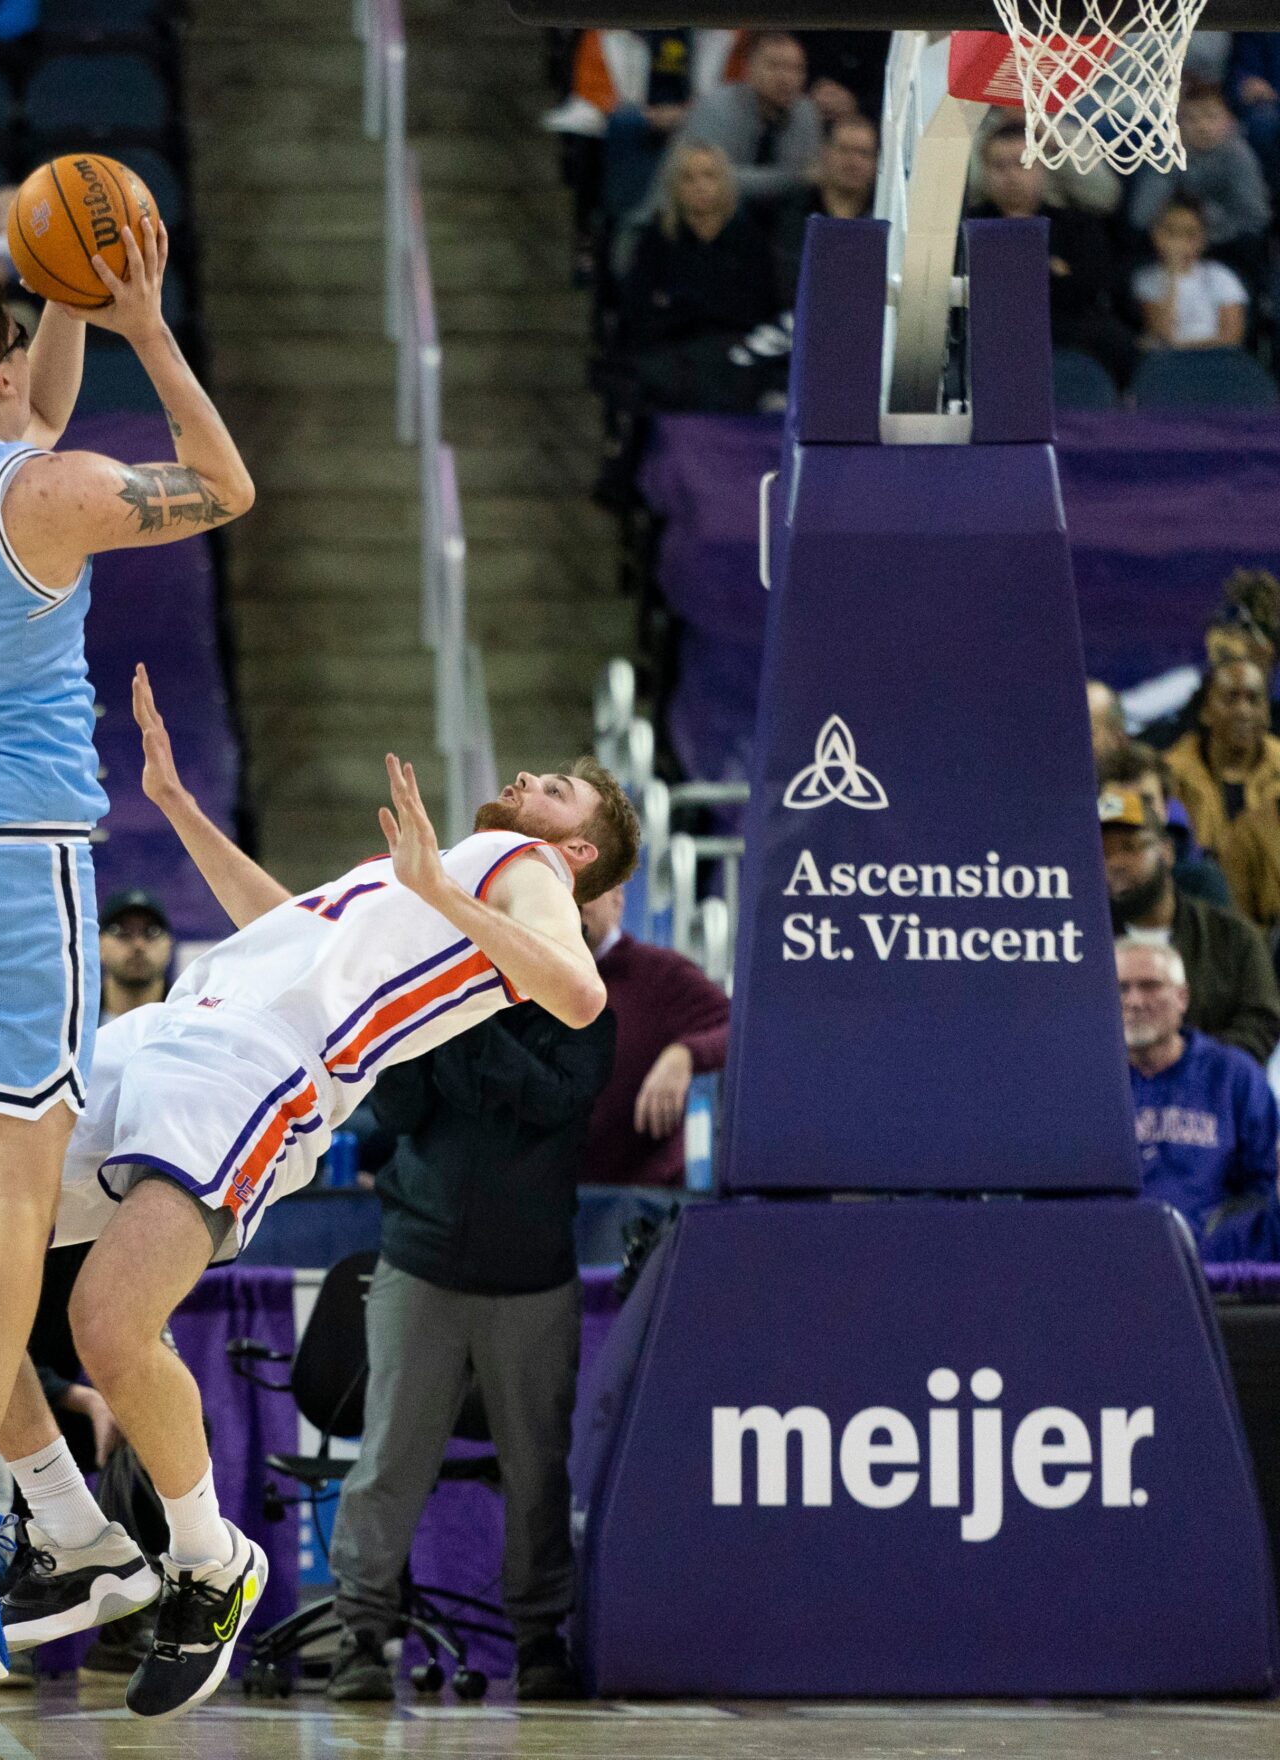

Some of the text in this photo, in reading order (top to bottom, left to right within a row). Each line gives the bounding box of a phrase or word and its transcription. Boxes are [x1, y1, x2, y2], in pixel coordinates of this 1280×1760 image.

[73, 158, 121, 251] Wilson
[782, 849, 1073, 900] Ascension
[782, 912, 1084, 963] St. Vincent
